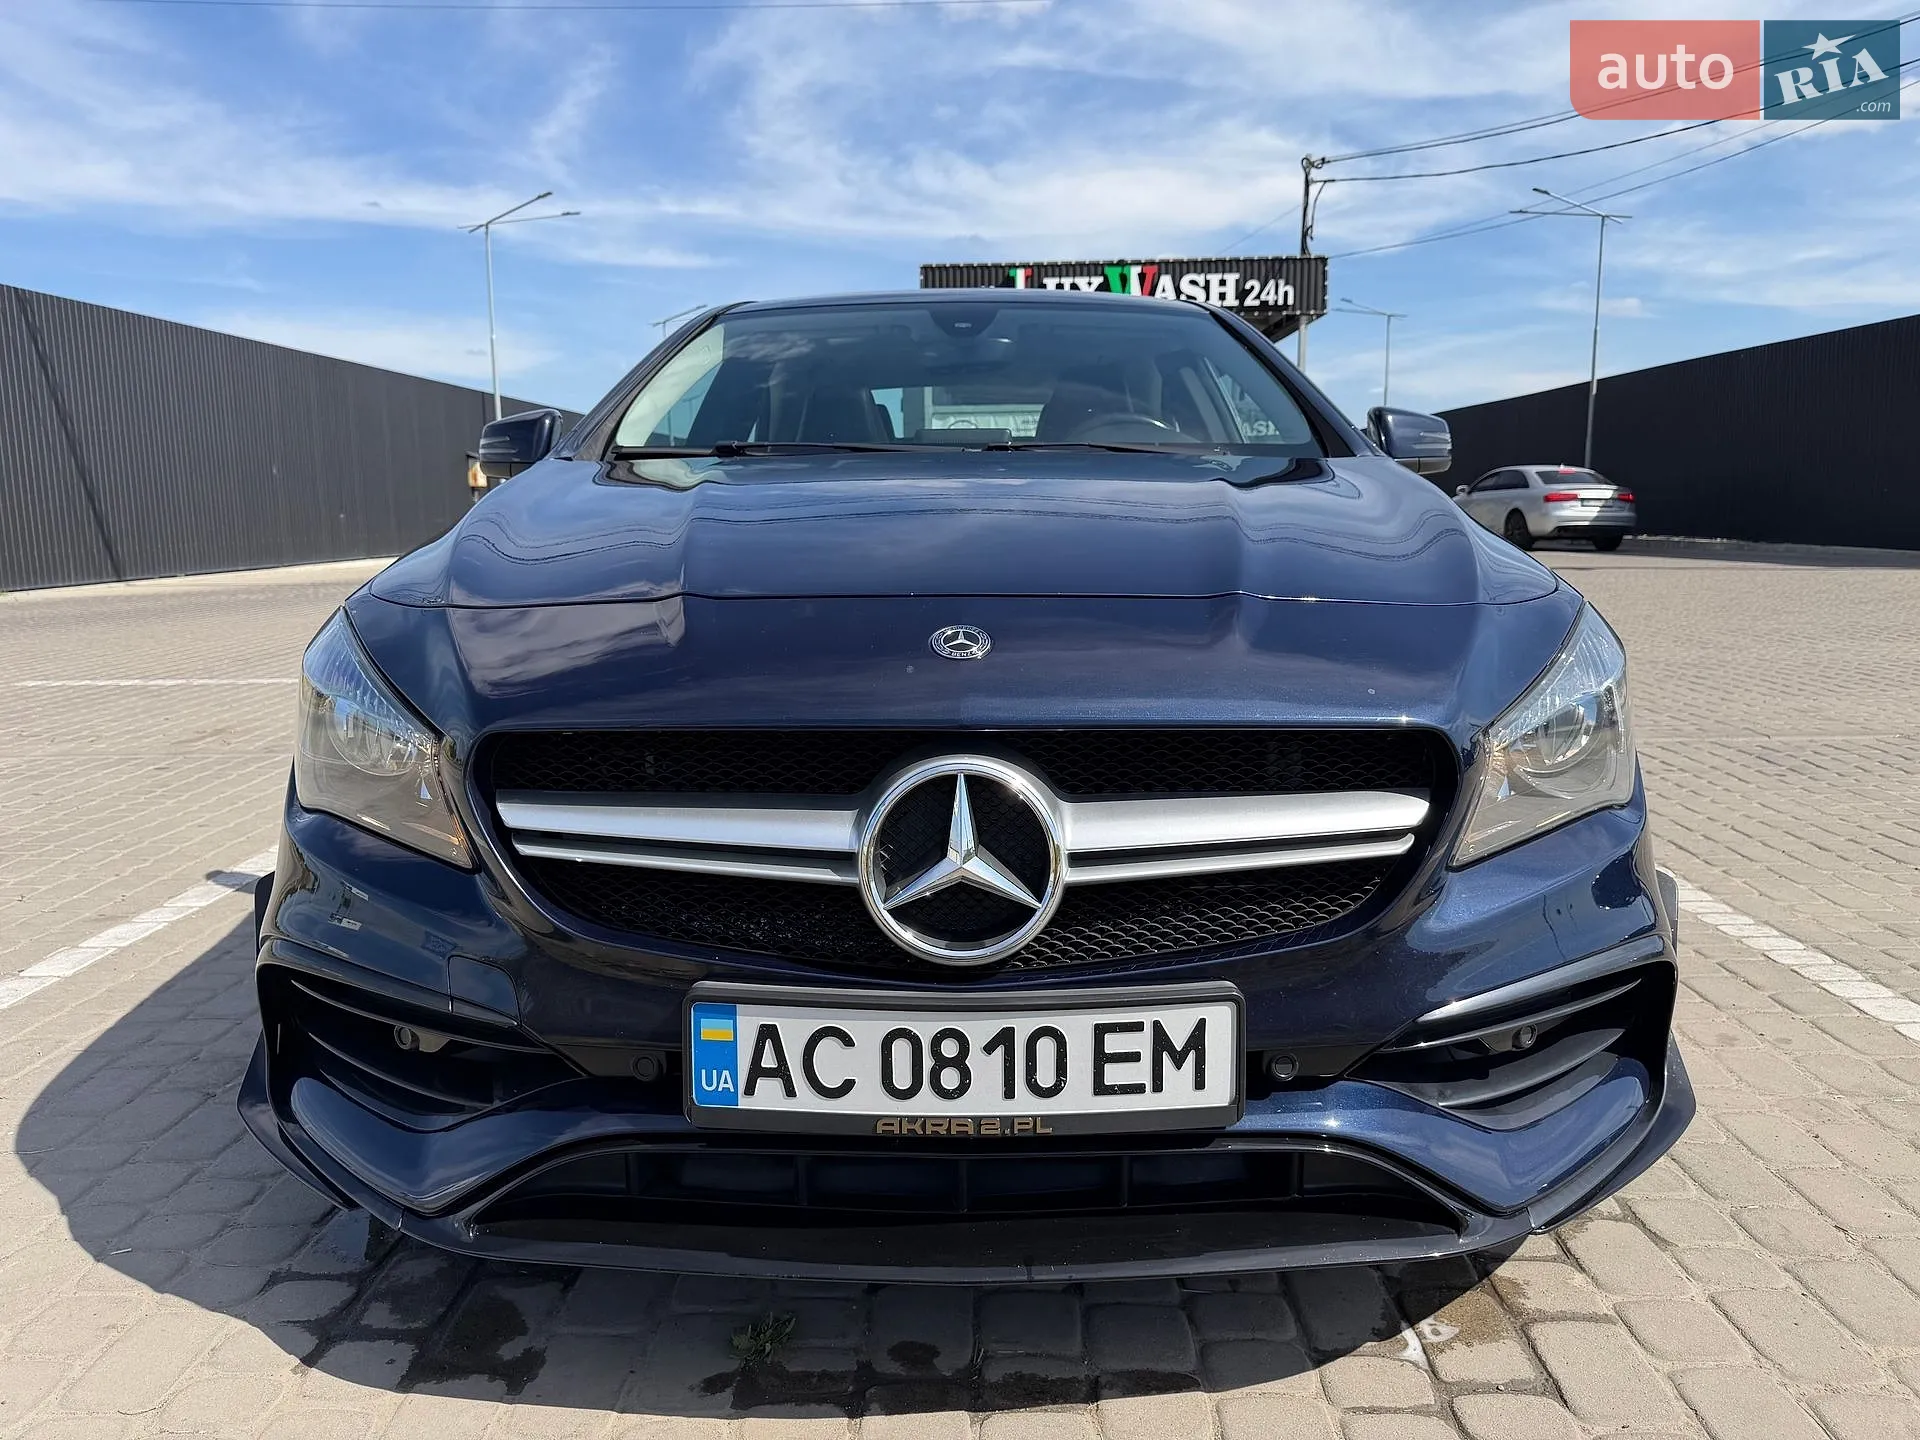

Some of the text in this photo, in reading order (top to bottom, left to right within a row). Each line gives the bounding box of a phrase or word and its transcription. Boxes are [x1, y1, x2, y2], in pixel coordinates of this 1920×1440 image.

[1243, 278, 1295, 307] 24h
[743, 1017, 1207, 1101] AC 0810 EM
[701, 1069, 735, 1092] UA
